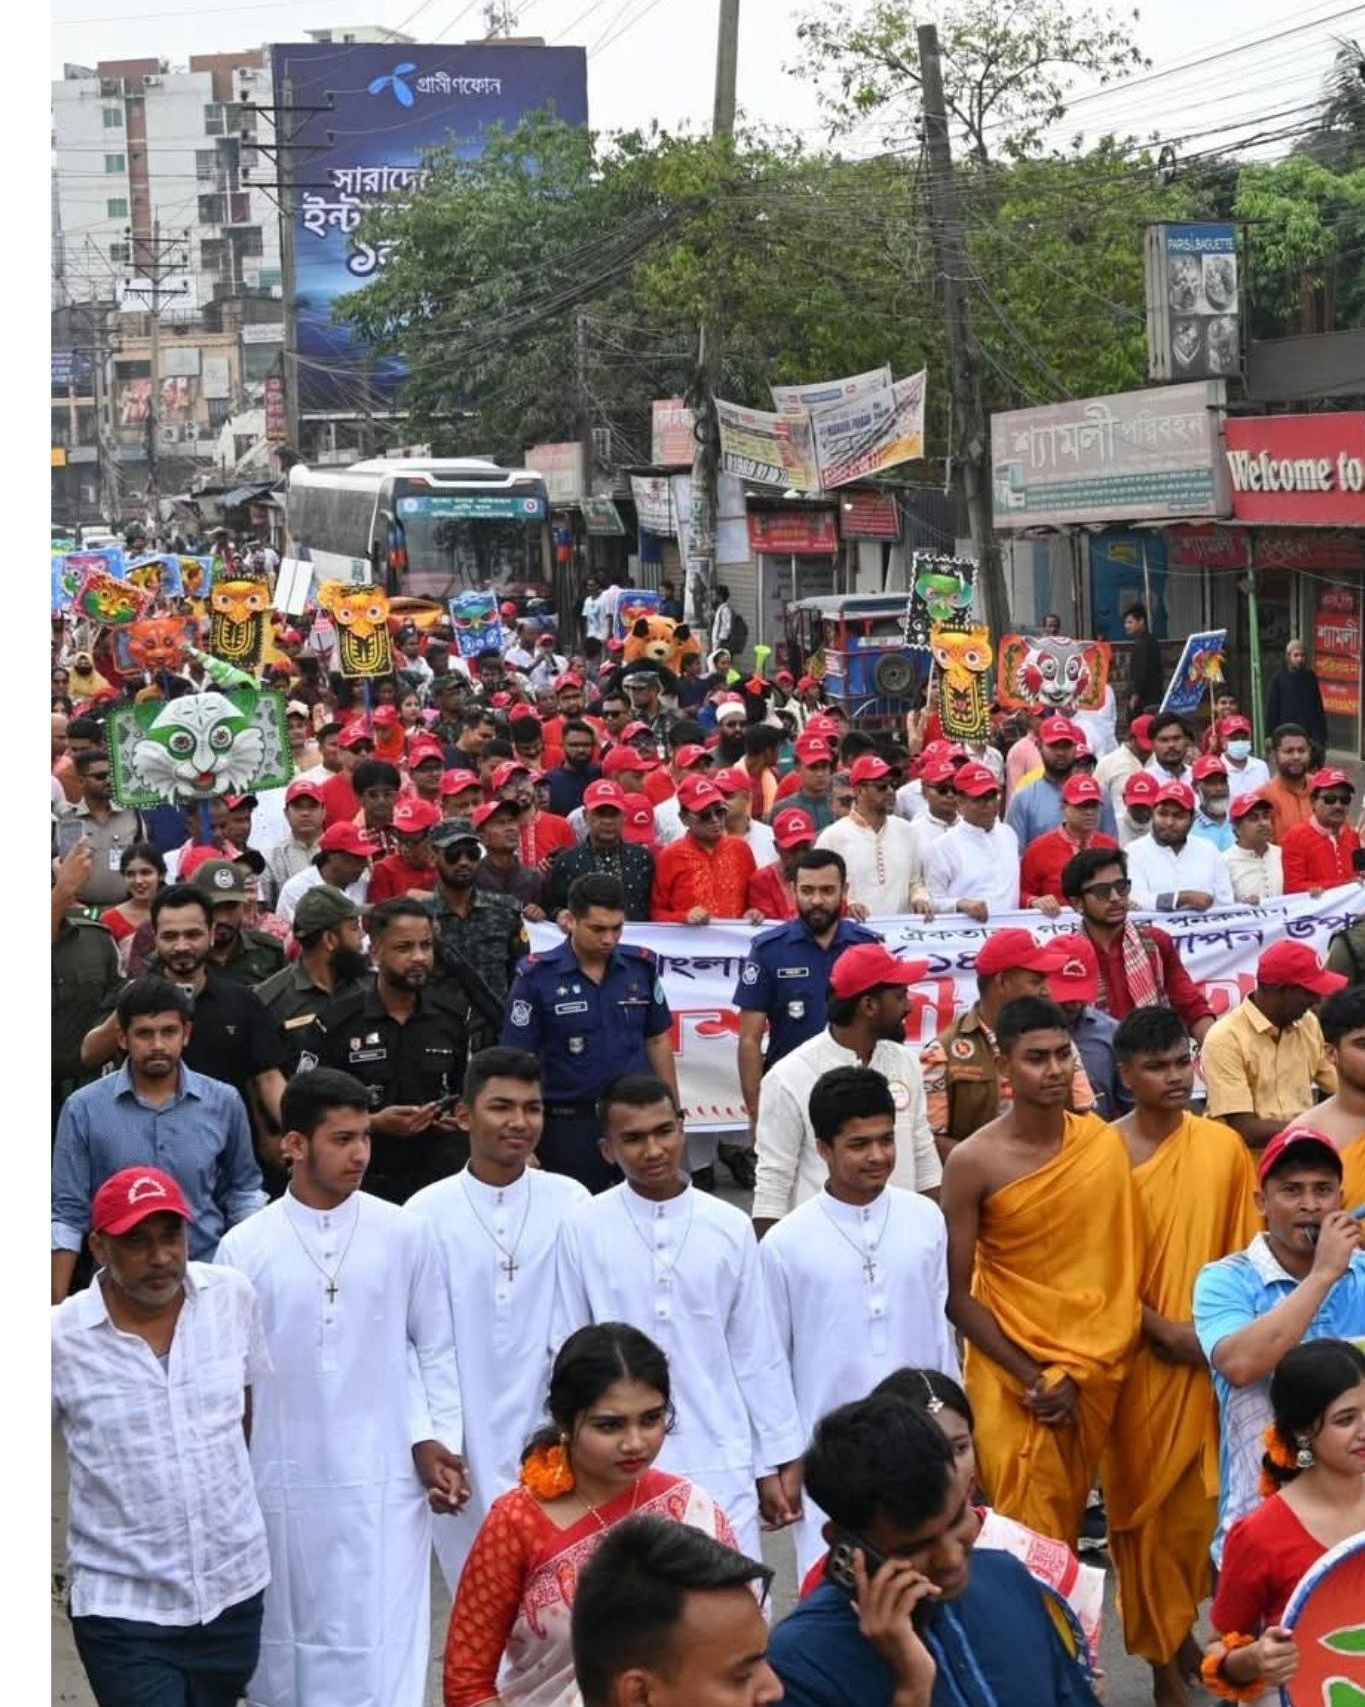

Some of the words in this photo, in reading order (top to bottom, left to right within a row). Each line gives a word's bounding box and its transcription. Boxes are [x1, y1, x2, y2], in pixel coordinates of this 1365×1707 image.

[416, 71, 502, 96] গ্রামীণফোন
[332, 165, 430, 194] সারাদে
[1012, 401, 1121, 469] শ্যামলী
[1227, 449, 1334, 494] Welcome
[1336, 451, 1365, 493] to
